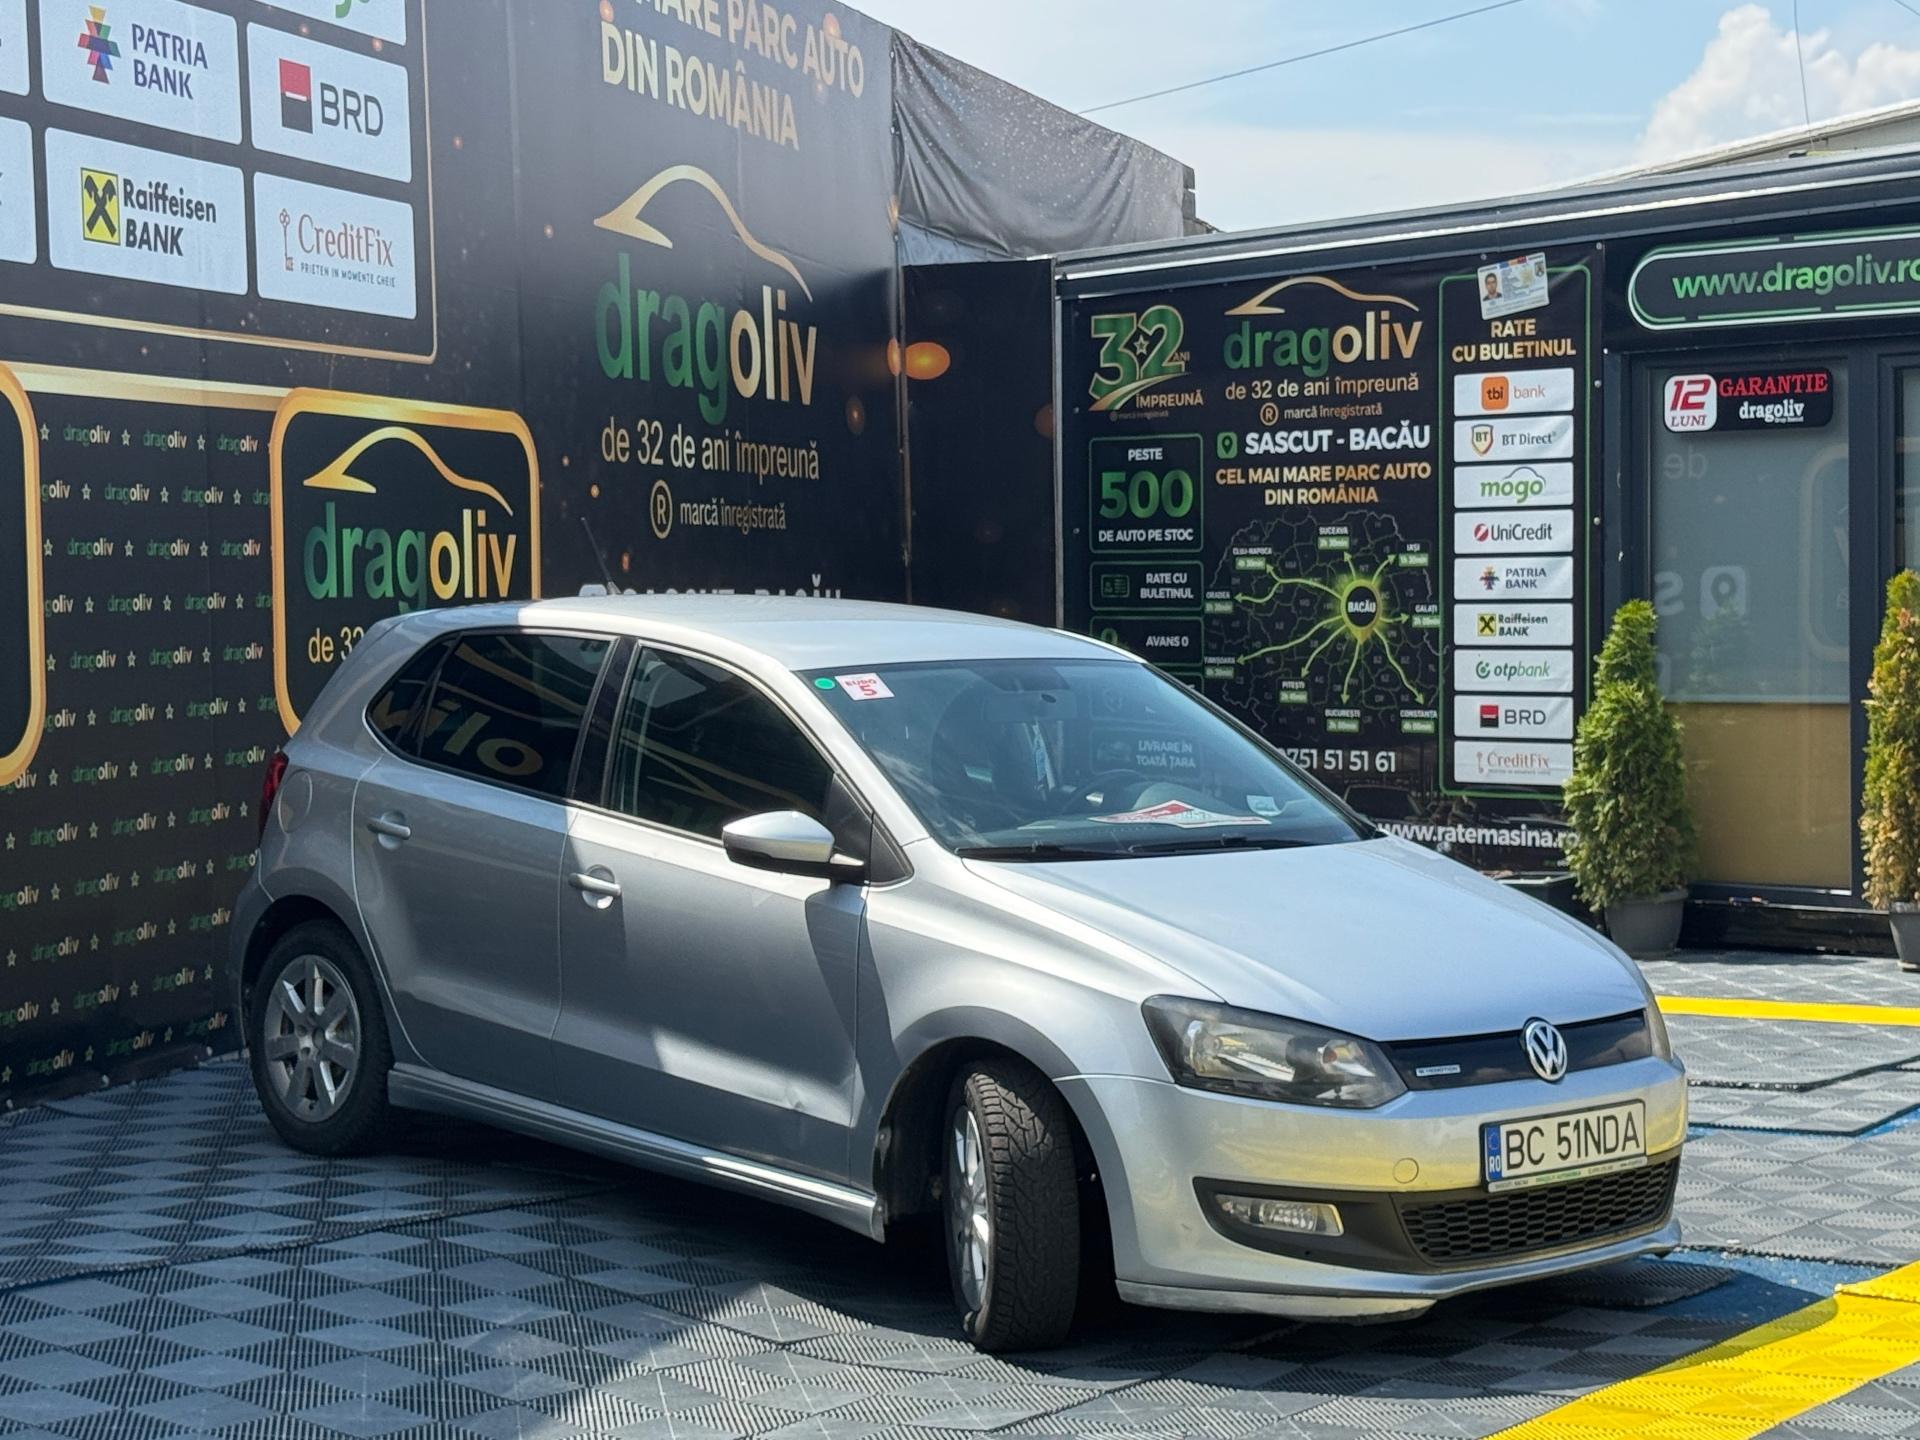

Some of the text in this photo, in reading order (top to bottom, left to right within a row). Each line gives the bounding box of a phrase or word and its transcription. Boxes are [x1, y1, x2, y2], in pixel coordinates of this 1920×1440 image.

[131, 23, 208, 69] PATRIA
[727, 0, 797, 69] PARC
[803, 24, 864, 98] AUTO
[134, 59, 194, 100] BANK
[601, 21, 799, 150] DIN ROMÂNIA
[320, 82, 383, 137] BRD
[123, 178, 216, 223] Raiffeisen
[125, 218, 184, 257] BANK
[298, 213, 394, 267] CreditFix
[595, 252, 816, 425] dragoliv
[1491, 319, 1536, 338] RATE
[1089, 305, 1184, 399] 32
[1223, 310, 1423, 377] dragoliv
[1452, 339, 1576, 362] CU BULETINUL
[1225, 372, 1419, 400] de 32 de ani împreună
[1486, 384, 1545, 401] tbi bank
[1670, 378, 1711, 412] 12
[1719, 373, 1829, 397] GARANTIE
[1136, 389, 1204, 408] ÎMPREUNĂ
[1284, 405, 1317, 419] marcă
[1319, 403, 1382, 420] înregistrată
[1670, 415, 1707, 427] LUNI
[1739, 399, 1804, 423] dragoliv
[63, 424, 258, 455] dragoliv dragoliv dragoliv
[1245, 429, 1333, 455] SASCUT
[1350, 420, 1430, 451] BACĂU
[1475, 431, 1488, 442] BT
[1502, 434, 1517, 446] BT
[602, 416, 820, 485] de 32 de ani împreună
[1128, 448, 1163, 461] PESTE
[1216, 462, 1432, 484] CEL MAI MARE PARC AUTO
[105, 483, 149, 504] dragoliv
[182, 486, 223, 506] dragoliv
[1100, 469, 1193, 519] 500
[1265, 484, 1379, 505] DIN ROMÂNIA
[1481, 480, 1544, 503] mogo
[680, 498, 718, 526] marcă
[721, 499, 786, 535] înregistrată
[1099, 528, 1193, 542] DE AUTO PE STOC
[1491, 524, 1552, 541] UniCredit
[67, 538, 261, 560] dragoliv dragoliv dragoliv
[304, 501, 516, 614] dragoliv
[1146, 572, 1187, 584] RATE CU
[1505, 567, 1546, 578] PATRIA
[1505, 578, 1537, 589] BANK
[107, 593, 152, 616] dragoliv
[184, 592, 226, 614] dragoliv
[1140, 587, 1194, 599] BULETINUL
[1348, 600, 1376, 613] BACĂU
[1498, 613, 1548, 625] Raiffeisen
[1146, 636, 1189, 647] AVANS 0
[1498, 627, 1529, 637] BANK
[70, 643, 263, 672] dragoliv dragoliv dragoliv
[308, 628, 334, 663] de
[1494, 661, 1550, 680] otpbank
[860, 684, 878, 696] 5
[110, 704, 155, 726] dragoliv
[186, 698, 228, 720] dragoliv
[1505, 709, 1546, 725] BRD
[1138, 740, 1193, 753] LIVRARE ÎN
[72, 746, 265, 784] dragoliv dragoliv dragoliv
[1136, 753, 1195, 769] TOATĂ ȚARA
[1324, 749, 1343, 770] 51
[1349, 750, 1368, 772] 51
[1375, 751, 1396, 773] 61
[1488, 751, 1550, 769] CreditFix
[30, 803, 230, 847] dragoliv dragoliv dragoliv
[75, 872, 120, 897] dragoliv
[154, 861, 196, 883] dragoliv
[31, 908, 231, 962] dragoliv dragoliv dragoliv
[73, 983, 120, 1011] dragoliv
[152, 968, 195, 992] dragoliv
[1506, 1126, 1544, 1171] BC
[1489, 1155, 1501, 1173] RO
